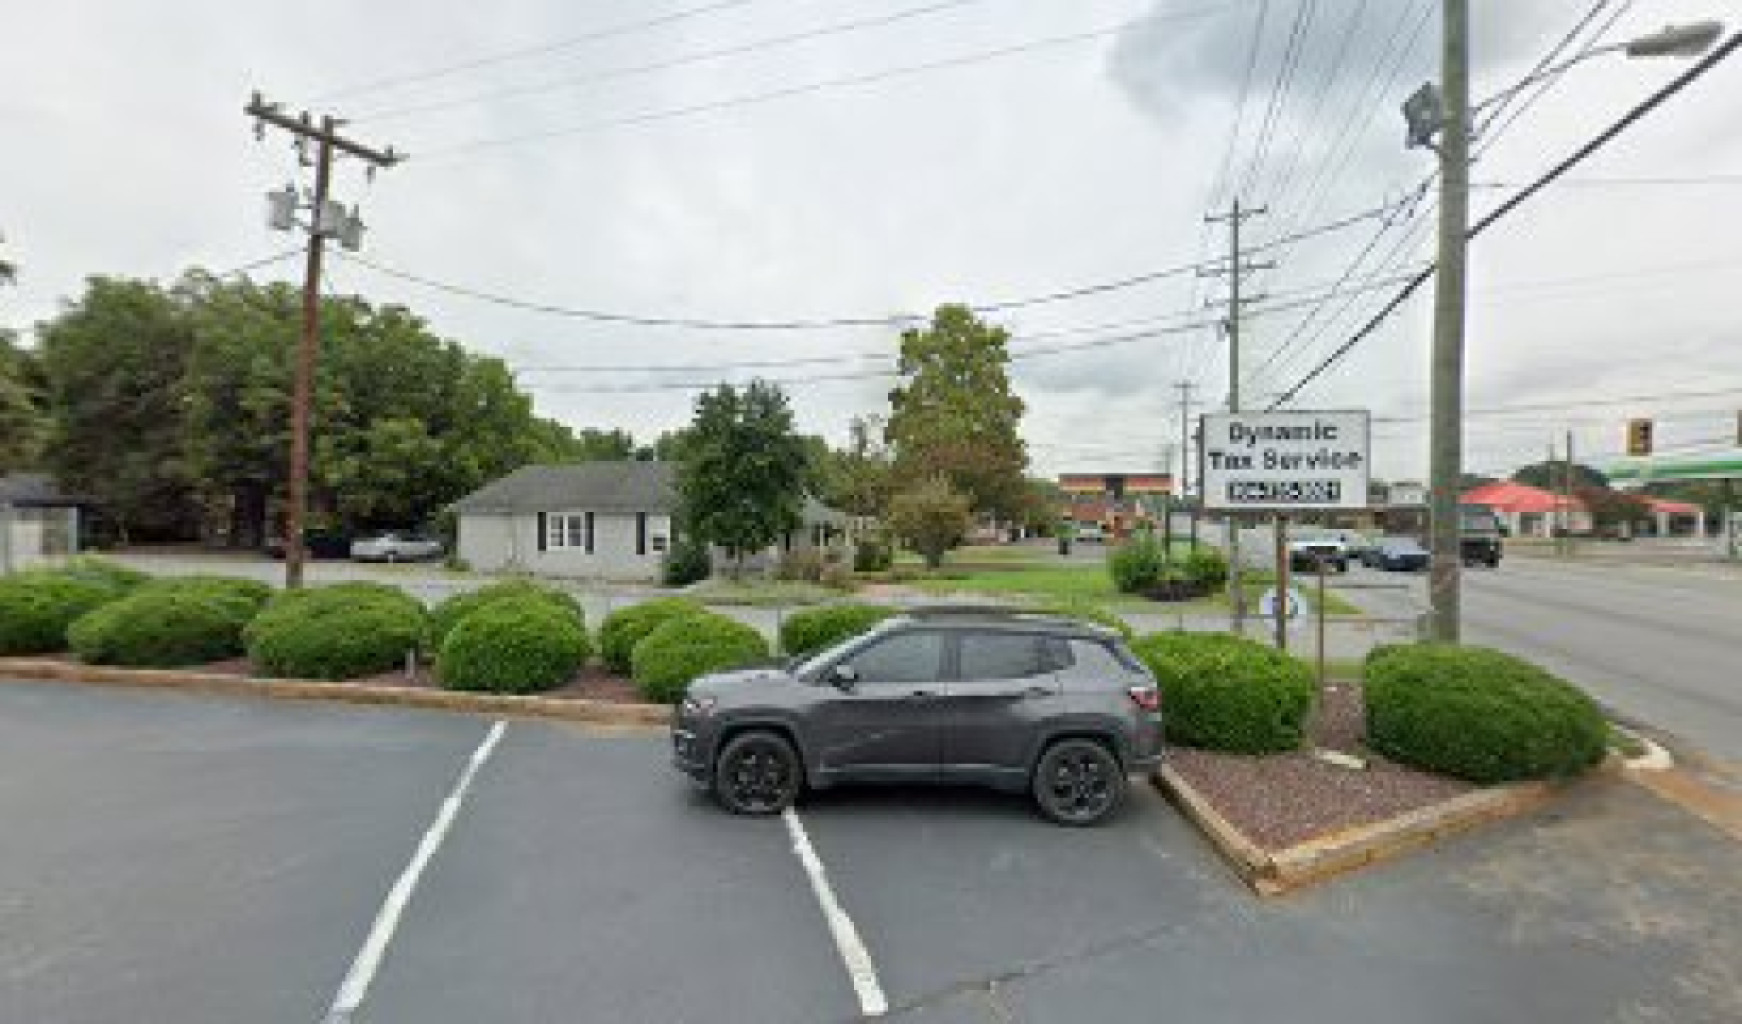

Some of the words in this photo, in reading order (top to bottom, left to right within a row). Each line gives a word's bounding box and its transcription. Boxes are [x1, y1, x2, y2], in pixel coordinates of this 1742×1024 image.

[1229, 420, 1338, 447] Dynamic
[1207, 451, 1253, 470] Tax
[1263, 449, 1363, 470] Service
